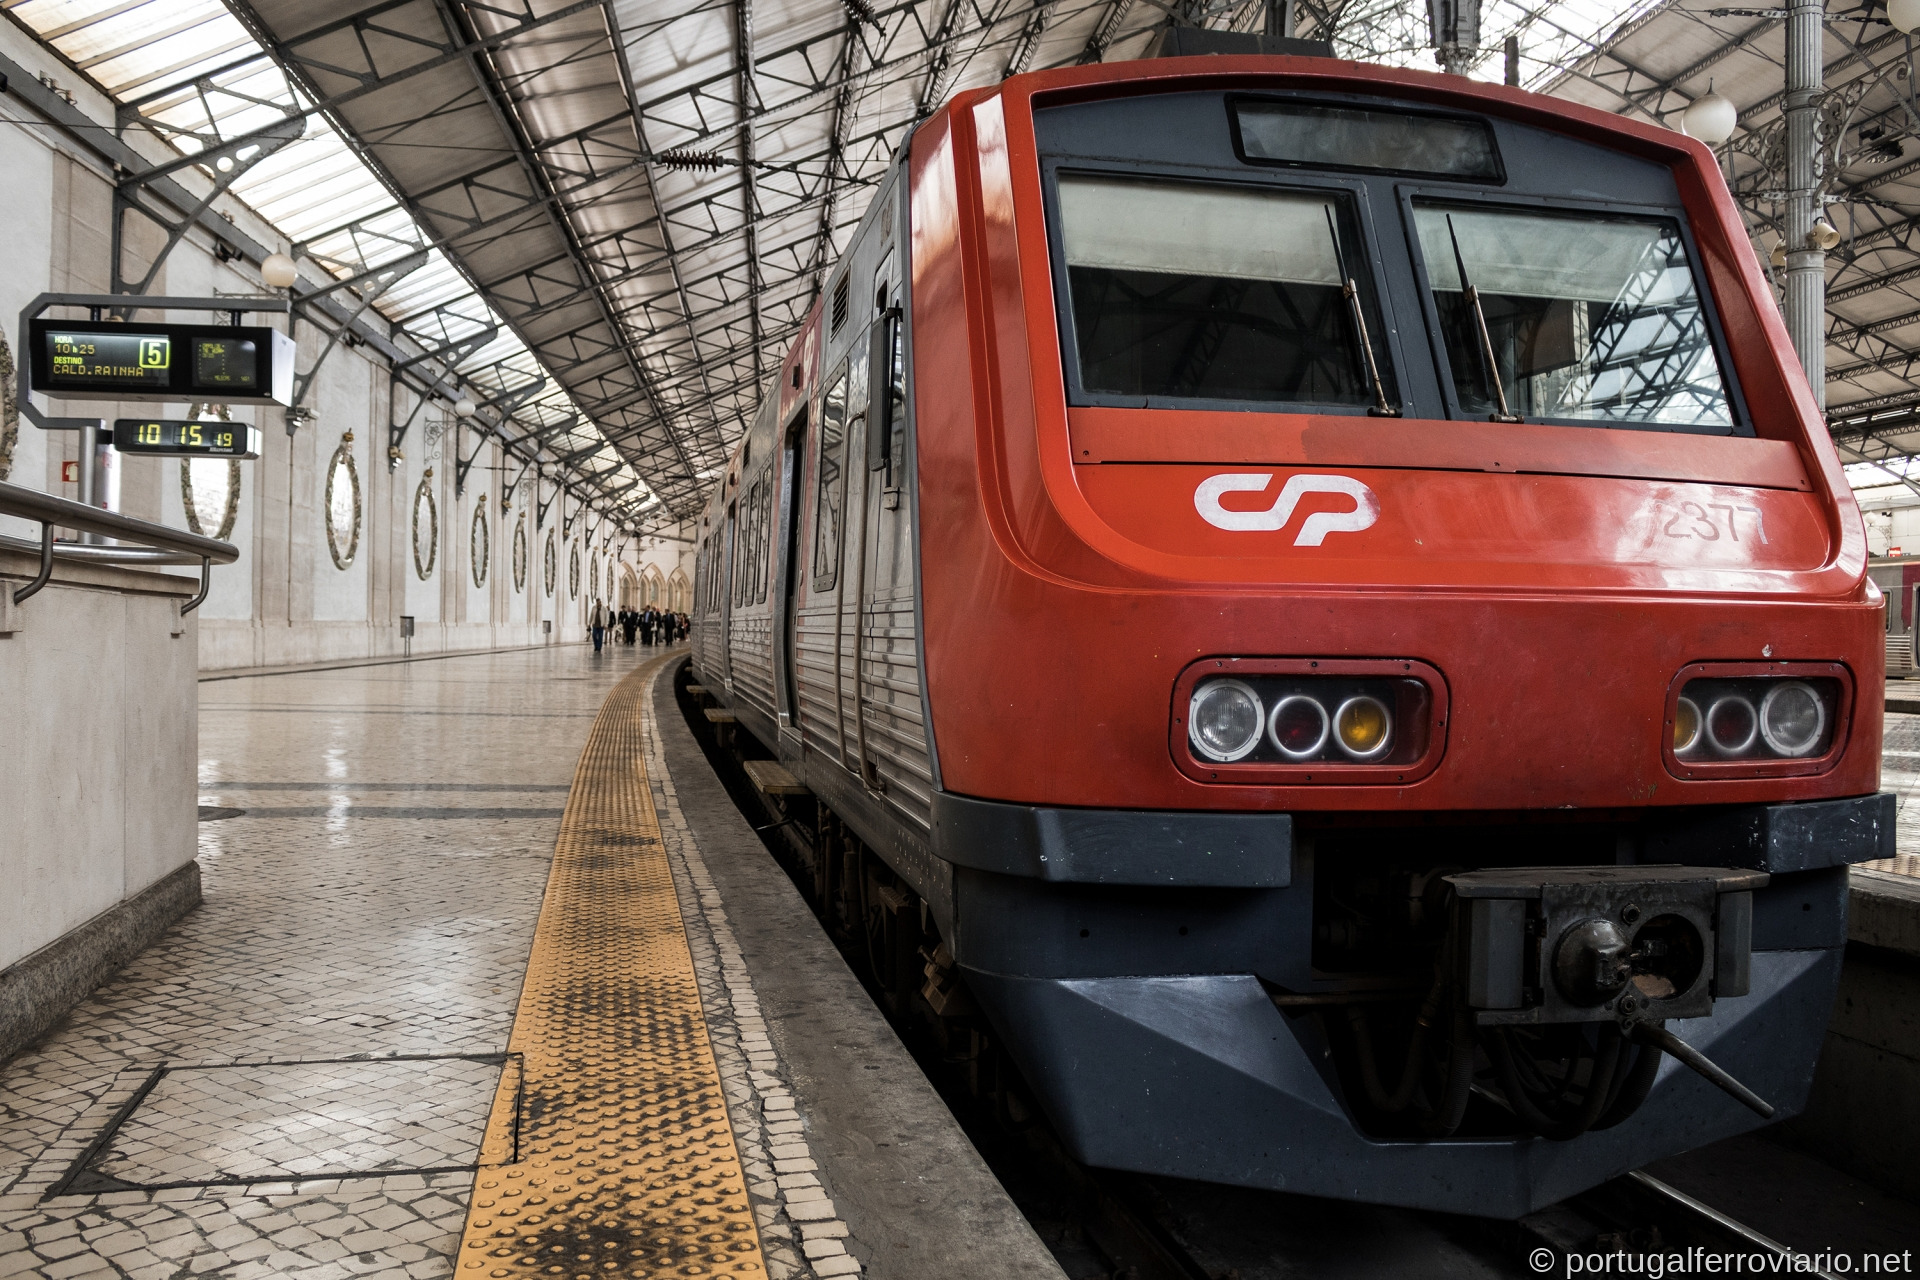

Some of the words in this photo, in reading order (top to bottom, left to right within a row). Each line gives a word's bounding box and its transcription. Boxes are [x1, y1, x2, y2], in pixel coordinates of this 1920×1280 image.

[54, 336, 73, 344] HORA
[147, 342, 161, 365] 5
[53, 356, 83, 365] DESTINO
[53, 364, 144, 377] CALD.RAINHA
[138, 423, 161, 445] 10
[180, 425, 203, 446] 15
[216, 432, 233, 447] 19
